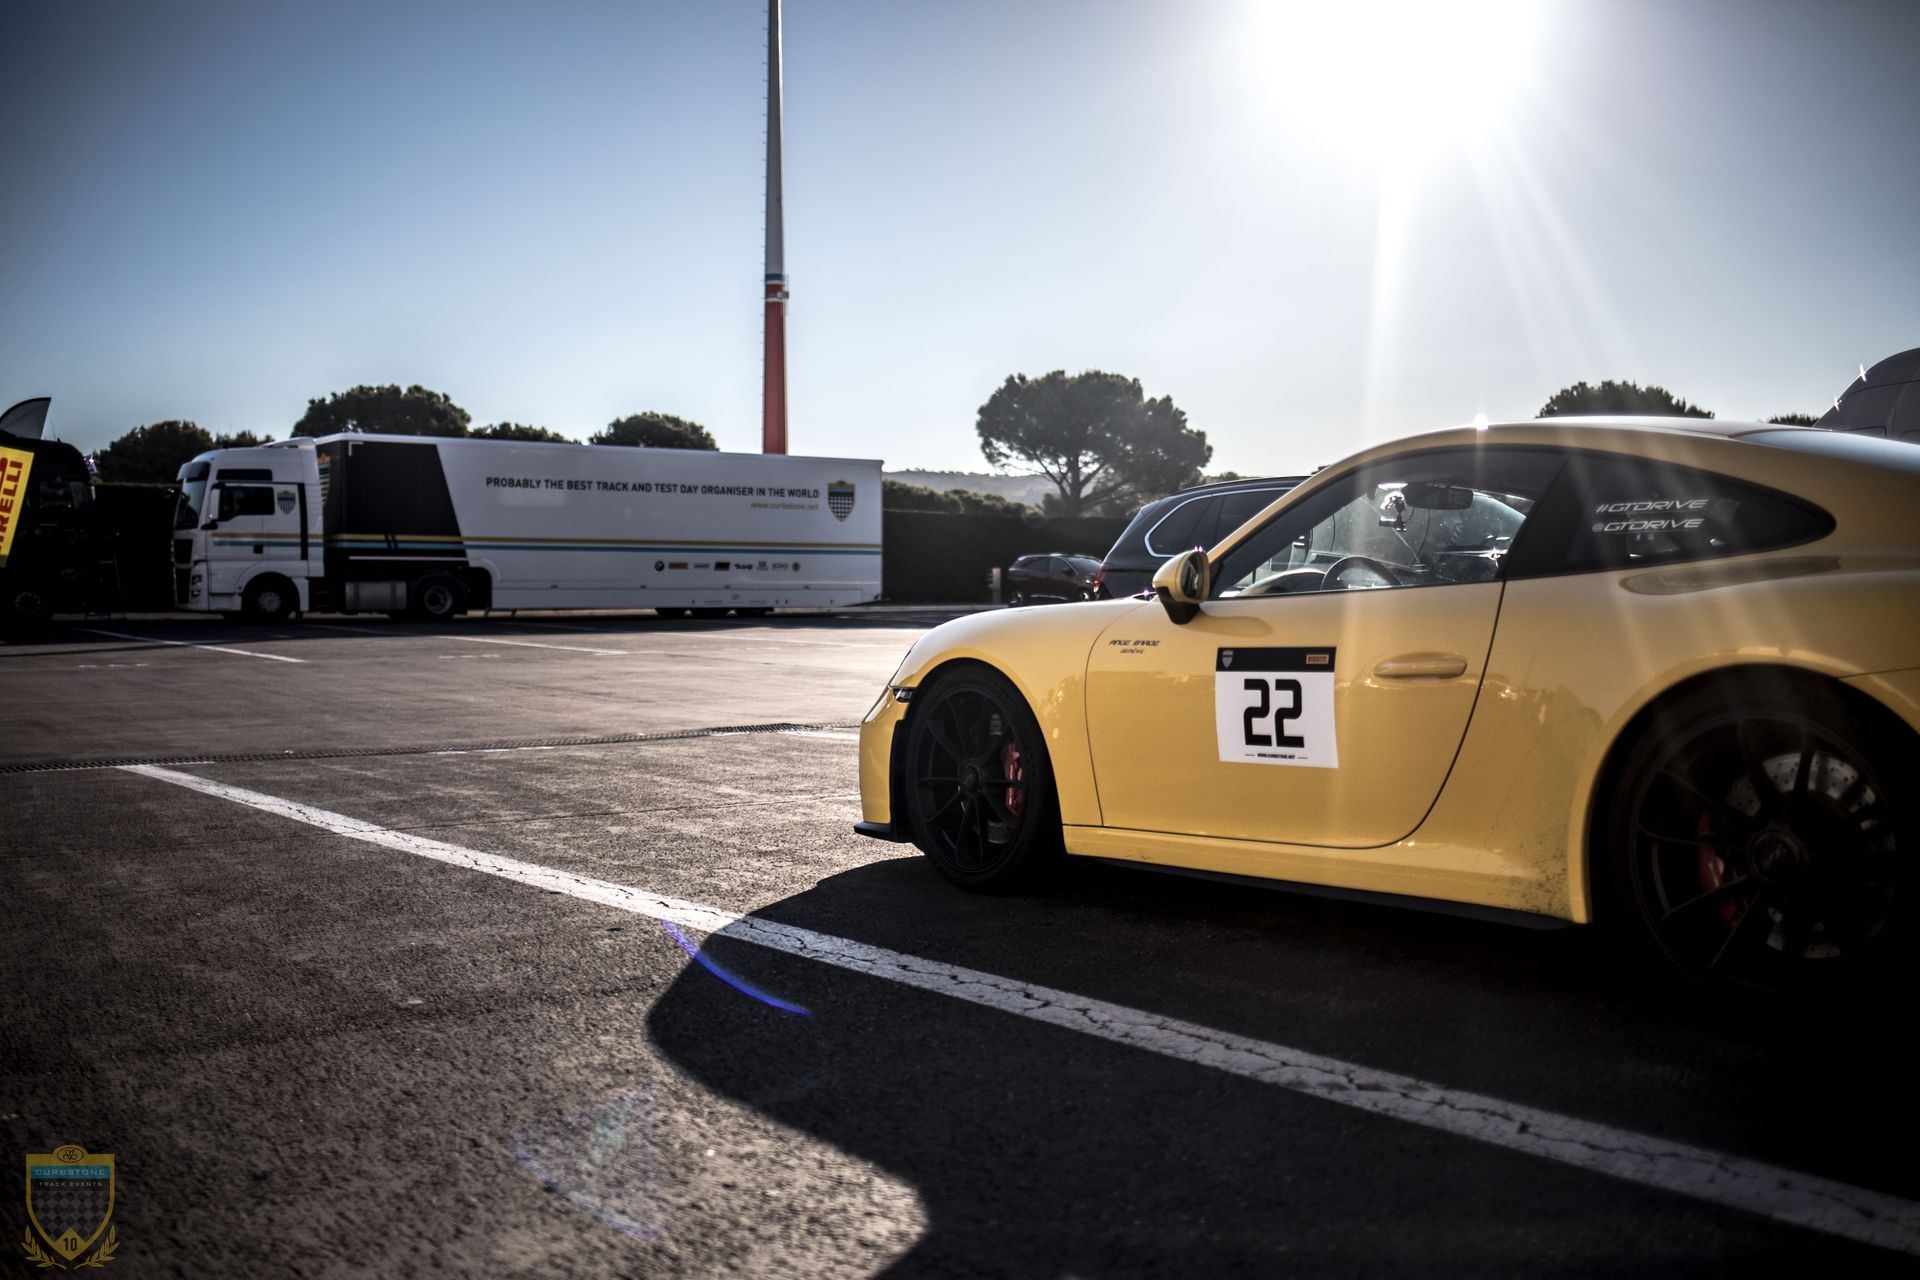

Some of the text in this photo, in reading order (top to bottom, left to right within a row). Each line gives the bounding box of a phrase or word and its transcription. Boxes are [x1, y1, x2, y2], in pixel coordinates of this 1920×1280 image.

[486, 477, 819, 499] PROBABLY THE BEST TRACK AND TEST DAY ORGANISER IN THE WORLD
[1243, 678, 1305, 749] 22
